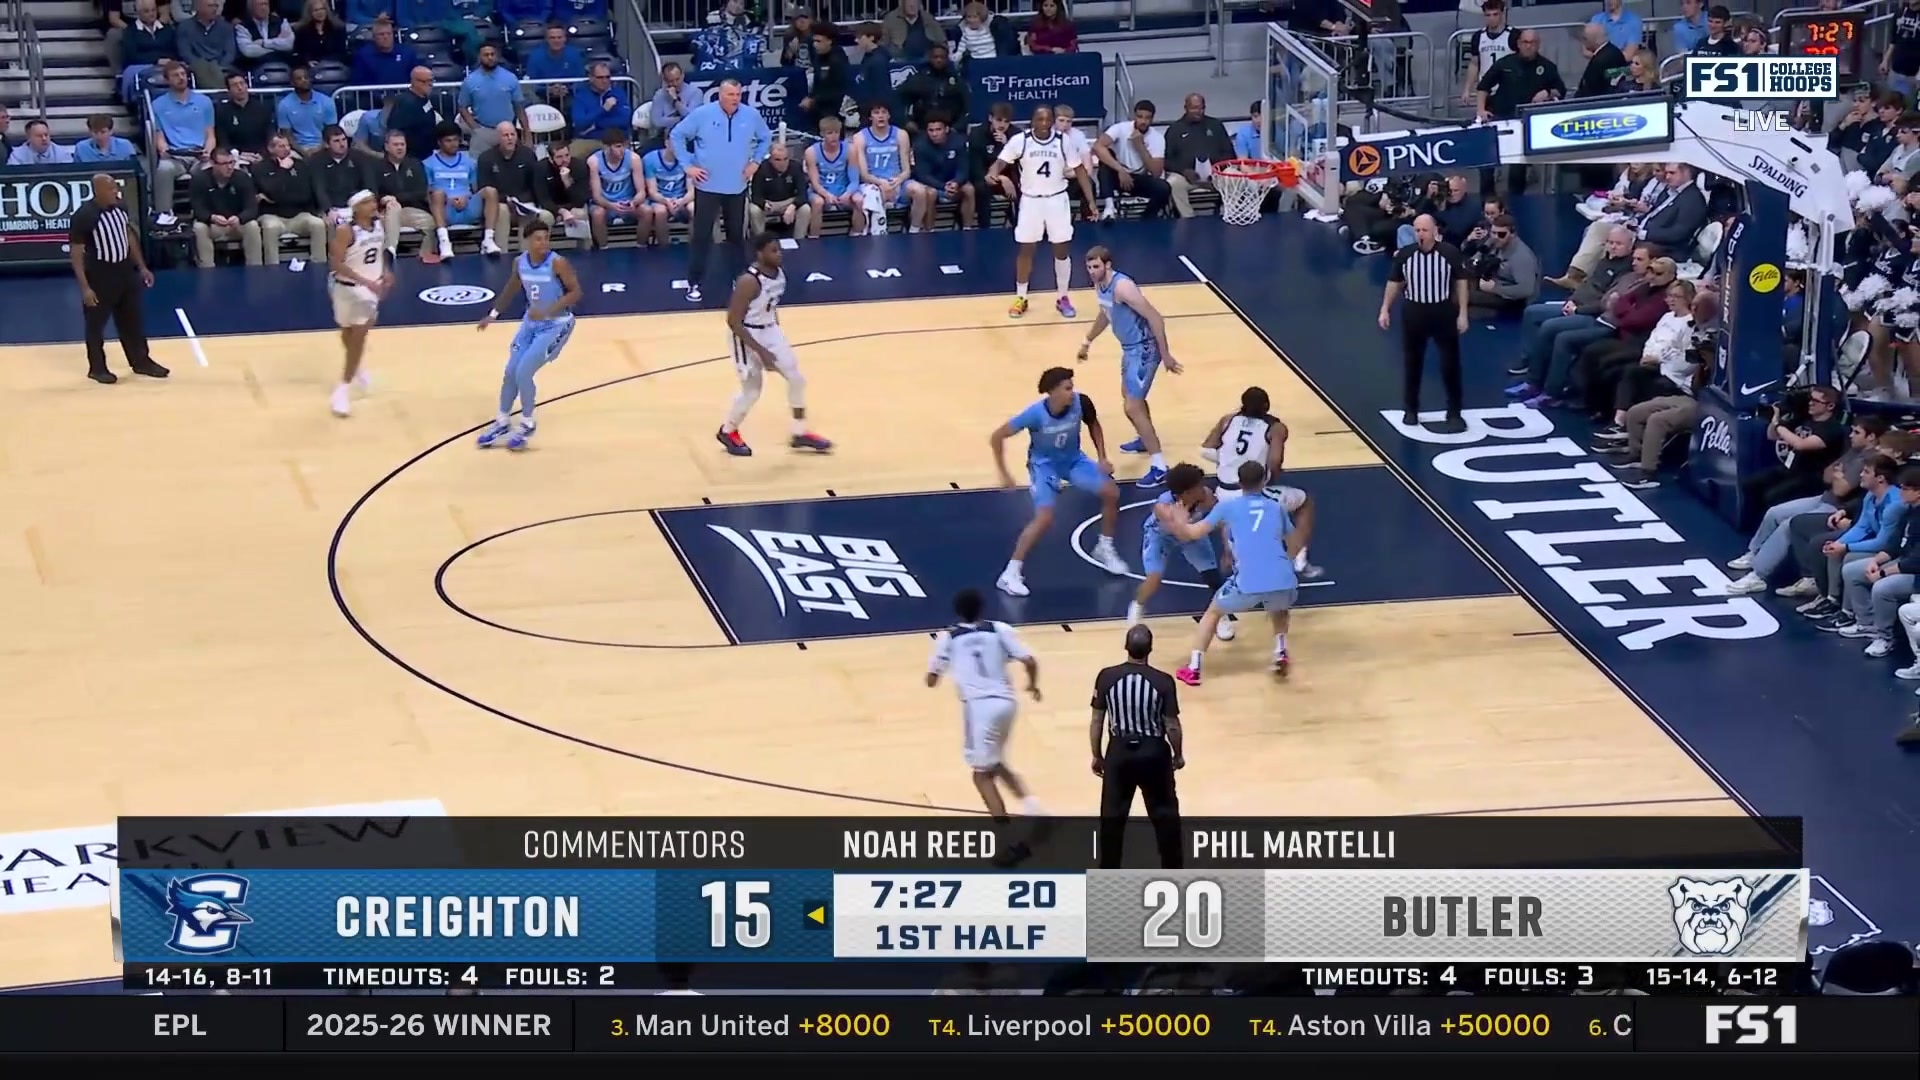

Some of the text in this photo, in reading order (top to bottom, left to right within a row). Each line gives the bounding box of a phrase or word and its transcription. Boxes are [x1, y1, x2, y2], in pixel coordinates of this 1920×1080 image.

[1807, 20, 1853, 42] 7:27
[1007, 74, 1090, 88] Franciscan
[1007, 90, 1058, 100] HEALTH
[1558, 115, 1638, 133] THIELE
[874, 153, 891, 168] 17
[1384, 139, 1457, 170] PNC
[1036, 160, 1051, 178] 4
[1748, 155, 1808, 199] SPALDING
[605, 182, 622, 193] 10
[664, 181, 676, 191] 4
[363, 247, 378, 265] 8
[1722, 222, 1745, 325] BUTLER
[530, 284, 540, 300] 2
[1235, 430, 1254, 456] 5
[1700, 415, 1734, 457] Pella
[1248, 509, 1265, 533] 7
[1379, 402, 1783, 652] BUTLER
[749, 529, 871, 620] EAST
[818, 534, 928, 598] BIG
[0, 815, 410, 874] ARKVIEW
